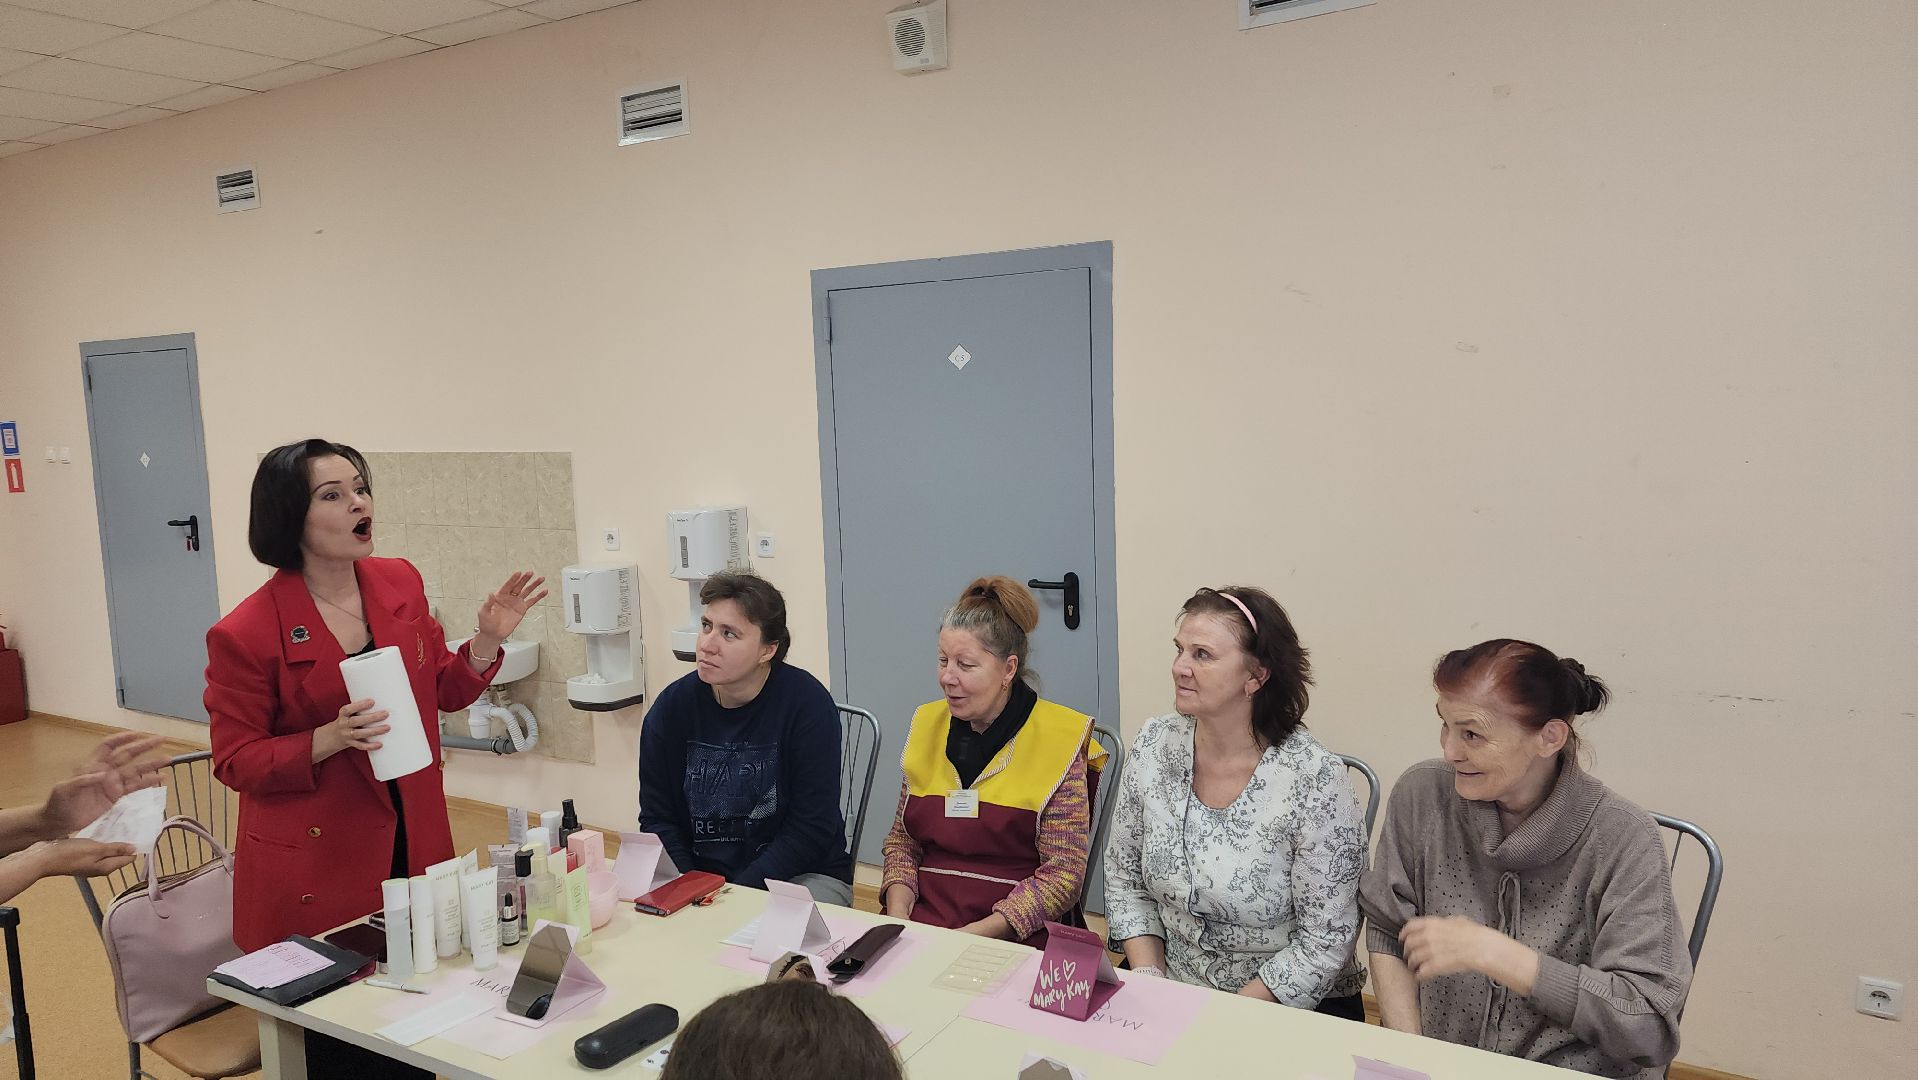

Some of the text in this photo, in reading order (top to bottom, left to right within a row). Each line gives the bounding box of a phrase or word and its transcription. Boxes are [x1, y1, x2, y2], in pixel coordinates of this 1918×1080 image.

[470, 978, 511, 997] MAR
[1033, 988, 1066, 1012] MARY
[1092, 1011, 1145, 1031] MAR
